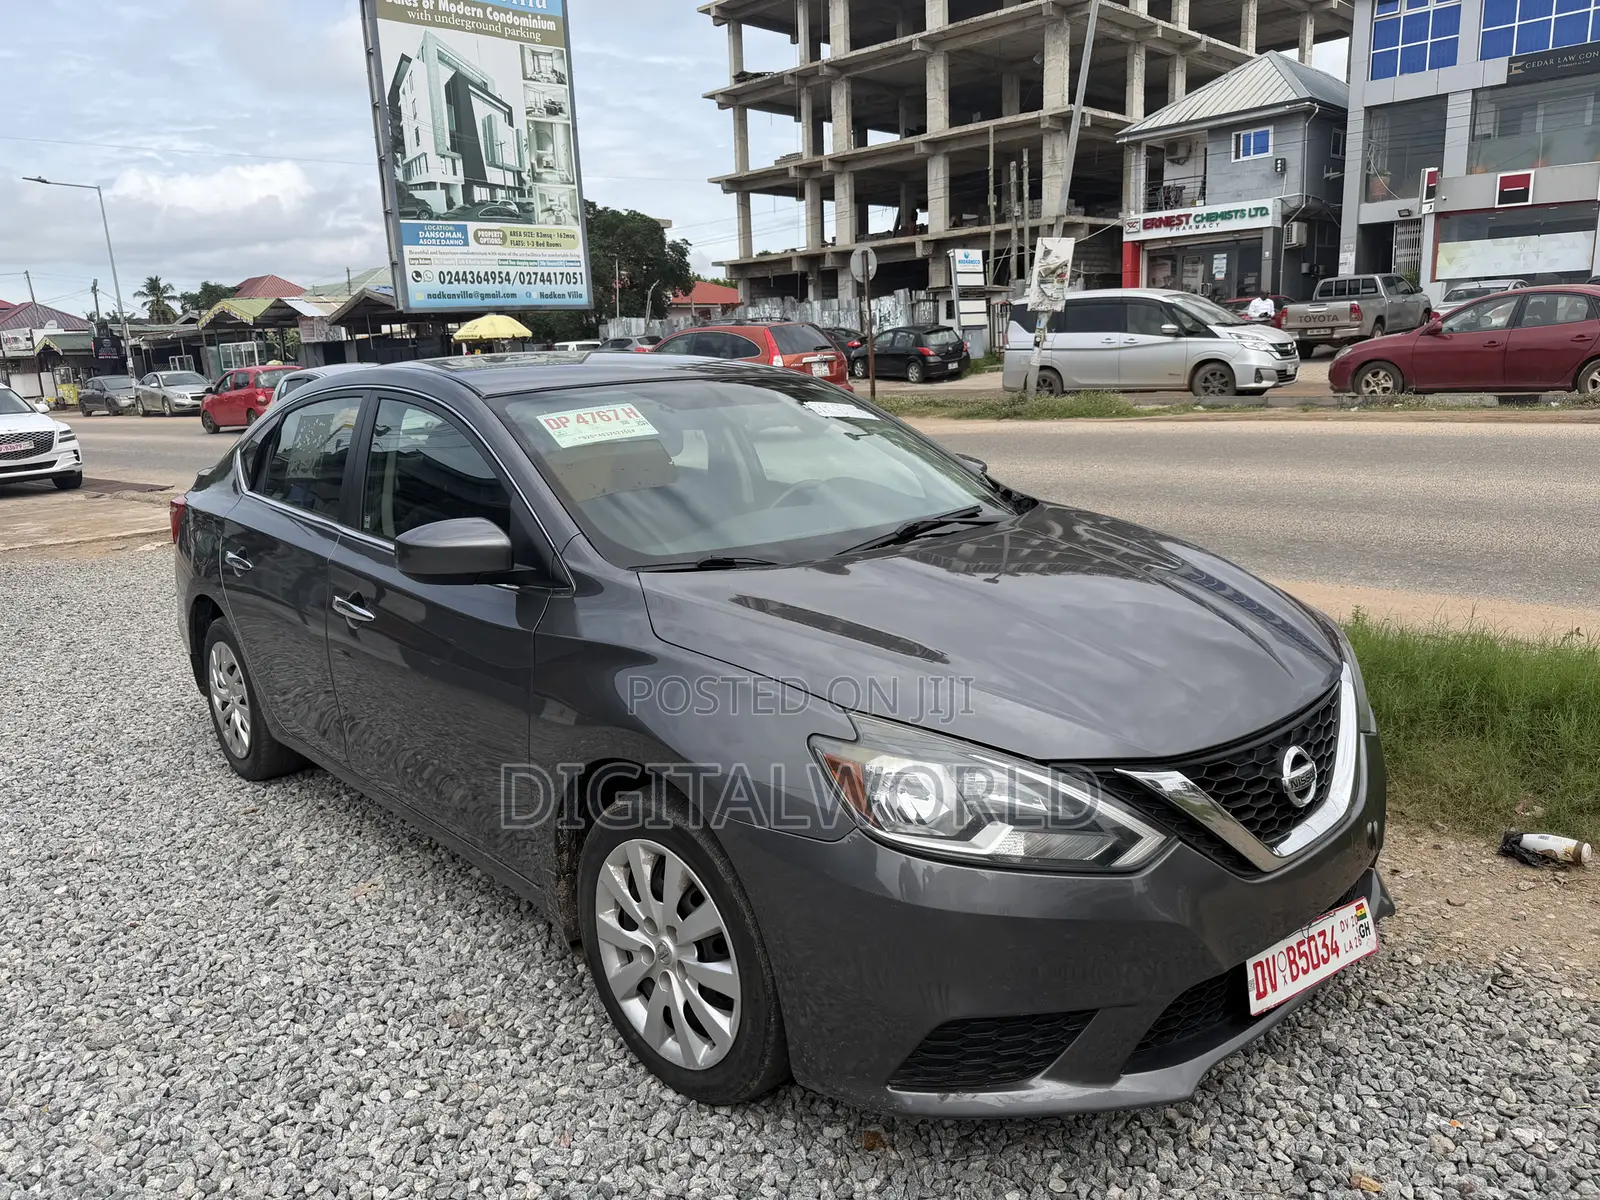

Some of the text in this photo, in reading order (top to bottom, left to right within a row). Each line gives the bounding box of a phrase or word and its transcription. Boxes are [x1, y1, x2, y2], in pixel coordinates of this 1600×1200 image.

[421, 0, 434, 9] of
[438, 0, 483, 18] Modern
[486, 7, 556, 31] Condominium
[407, 9, 541, 42] with underground parking
[1525, 59, 1554, 69] CEDAR
[1557, 54, 1576, 64] LAW
[1142, 206, 1270, 230] ERNEST CHEMISTS LTD.
[477, 230, 503, 238] PROPERTY
[1169, 222, 1221, 233] PHARMACY
[438, 270, 584, 287] 0244364954/0274417051
[427, 290, 517, 301] nadkanvilla@gmail.com
[539, 291, 583, 299] Nadkan Villa
[1297, 314, 1340, 323] TOYOTA
[544, 407, 640, 430] DP 4767 H
[1339, 918, 1349, 933] DV
[1359, 921, 1371, 938] GH
[1344, 940, 1354, 954] LA
[1252, 954, 1278, 1001] DV
[1285, 925, 1340, 983] B5034
